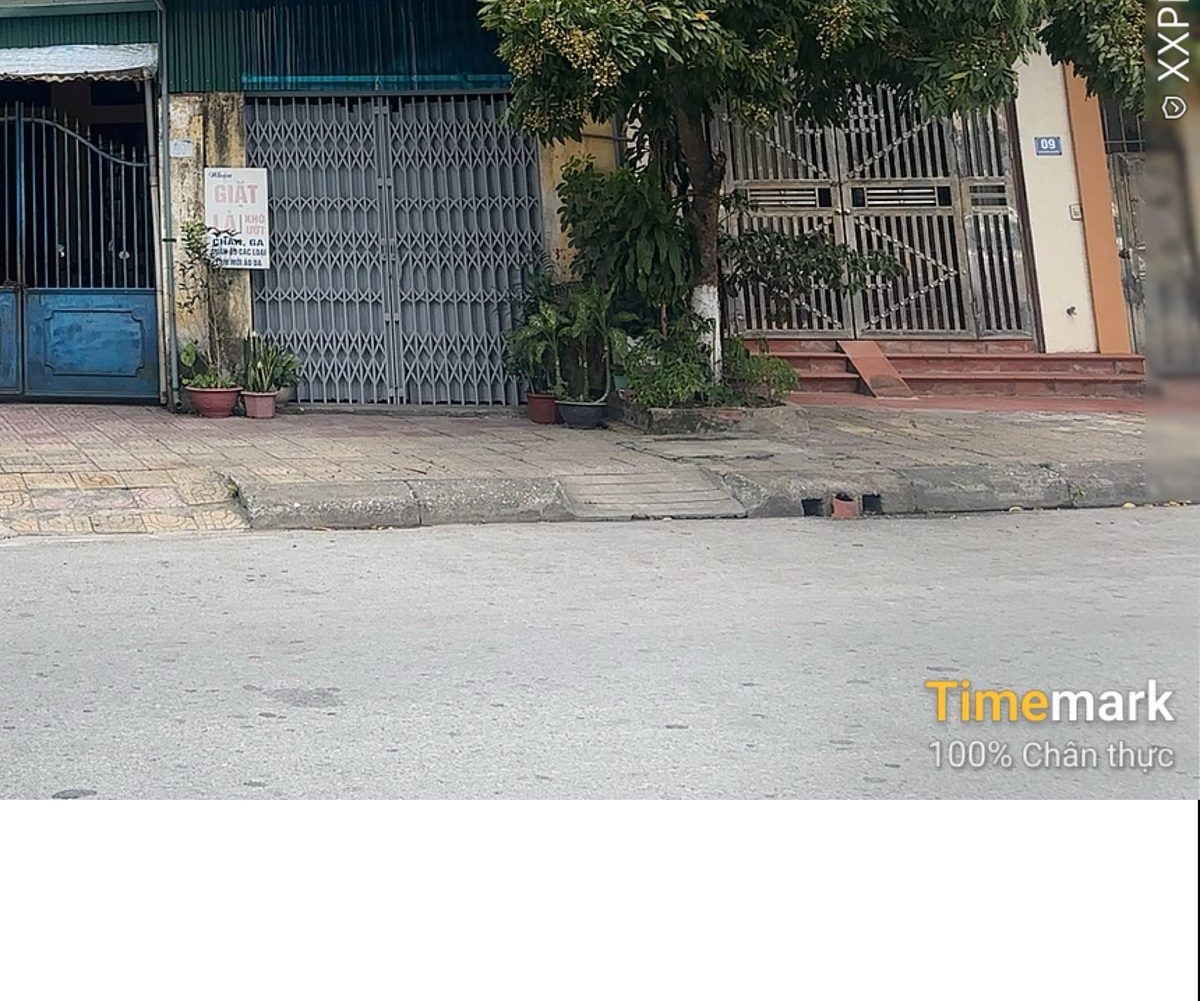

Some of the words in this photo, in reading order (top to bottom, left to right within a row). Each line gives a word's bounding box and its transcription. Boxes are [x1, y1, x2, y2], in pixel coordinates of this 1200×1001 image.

[1040, 138, 1056, 150] 09
[214, 180, 258, 207] GIẶT
[249, 238, 264, 247] GA
